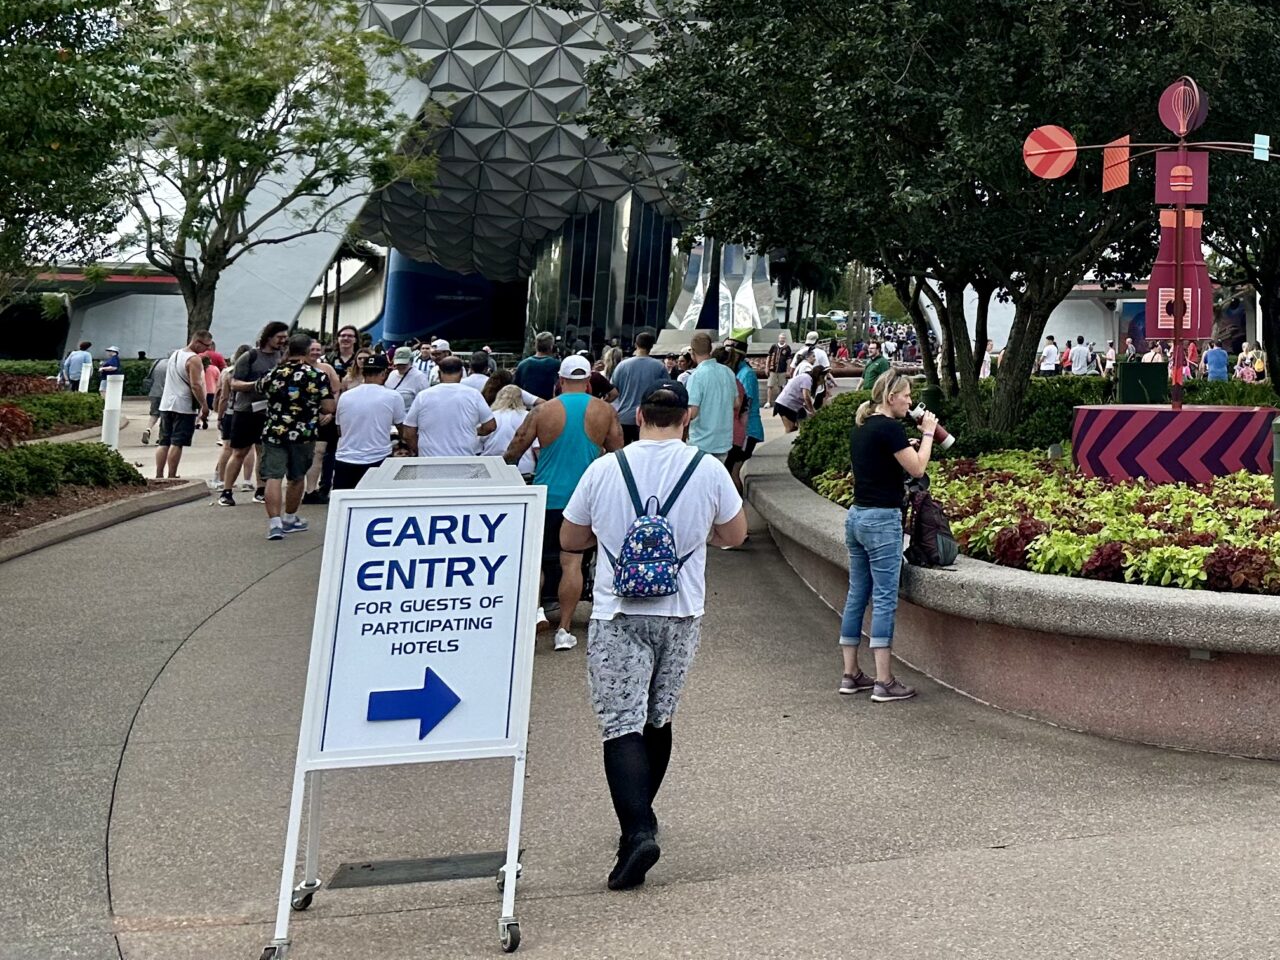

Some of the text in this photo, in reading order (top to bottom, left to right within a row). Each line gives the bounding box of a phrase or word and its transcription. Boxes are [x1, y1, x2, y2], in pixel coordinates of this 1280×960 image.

[366, 513, 508, 547] EARLY
[357, 555, 508, 591] ENTRY
[354, 596, 503, 615] FOR GUESTS OF
[361, 617, 493, 636] PARTICIPATING
[391, 640, 459, 655] HOTELS
